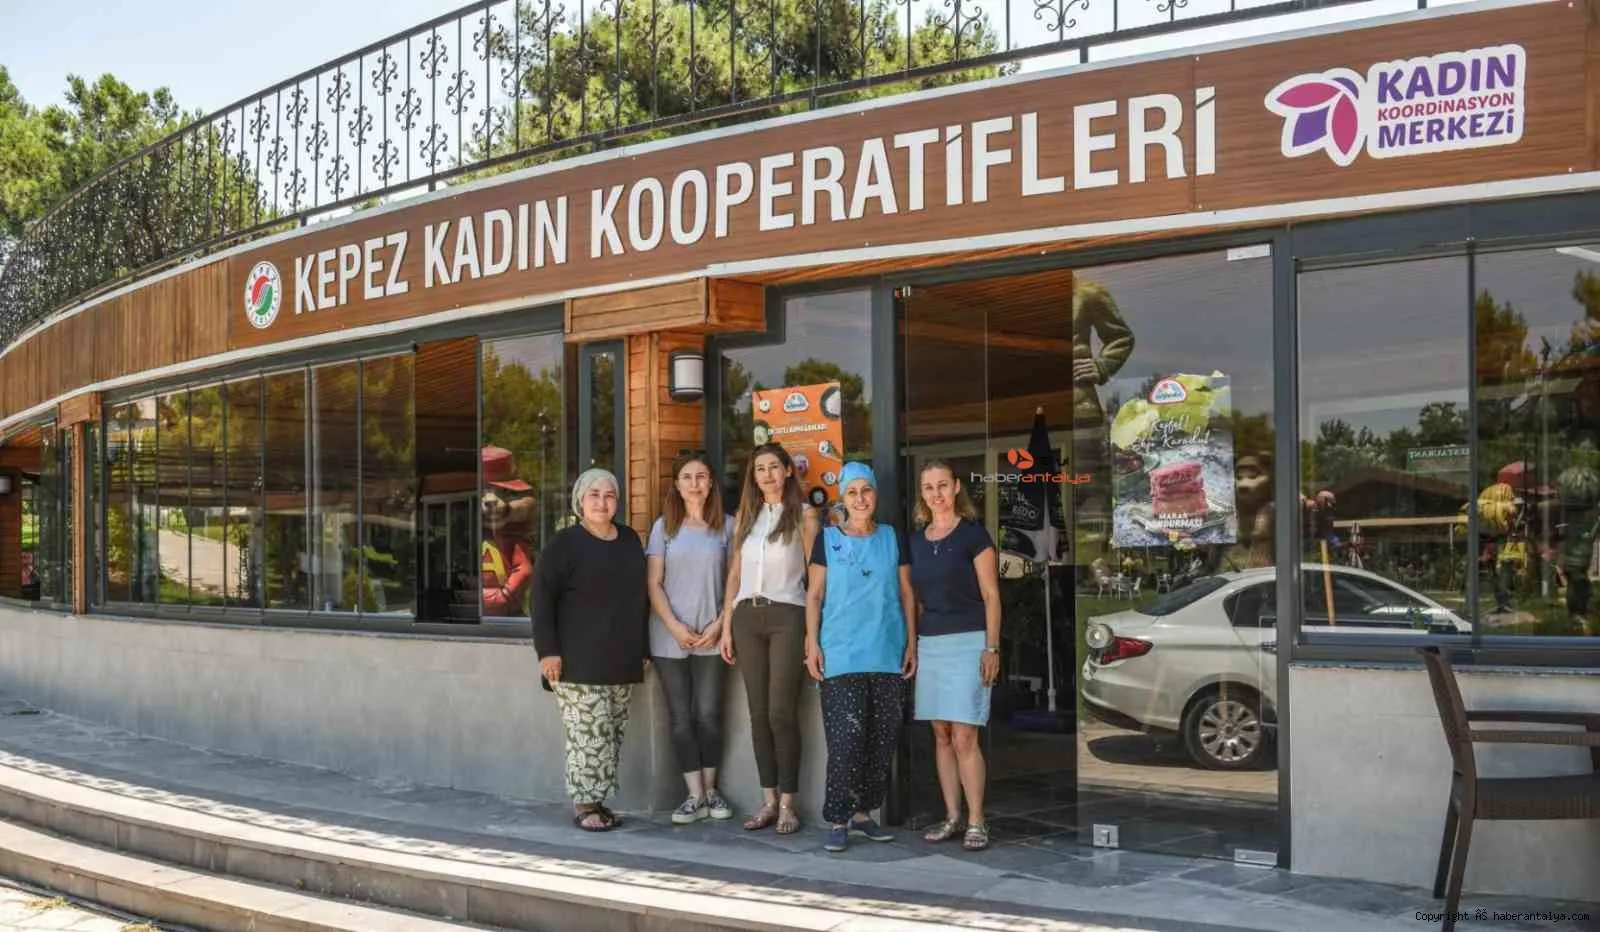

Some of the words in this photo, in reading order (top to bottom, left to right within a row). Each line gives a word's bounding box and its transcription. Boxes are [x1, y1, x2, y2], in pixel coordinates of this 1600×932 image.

[1378, 54, 1516, 103] KADIN
[294, 231, 410, 315] KEPEZ
[424, 195, 568, 287] KADIN
[591, 85, 1217, 257] KOOPERATİFLERİ
